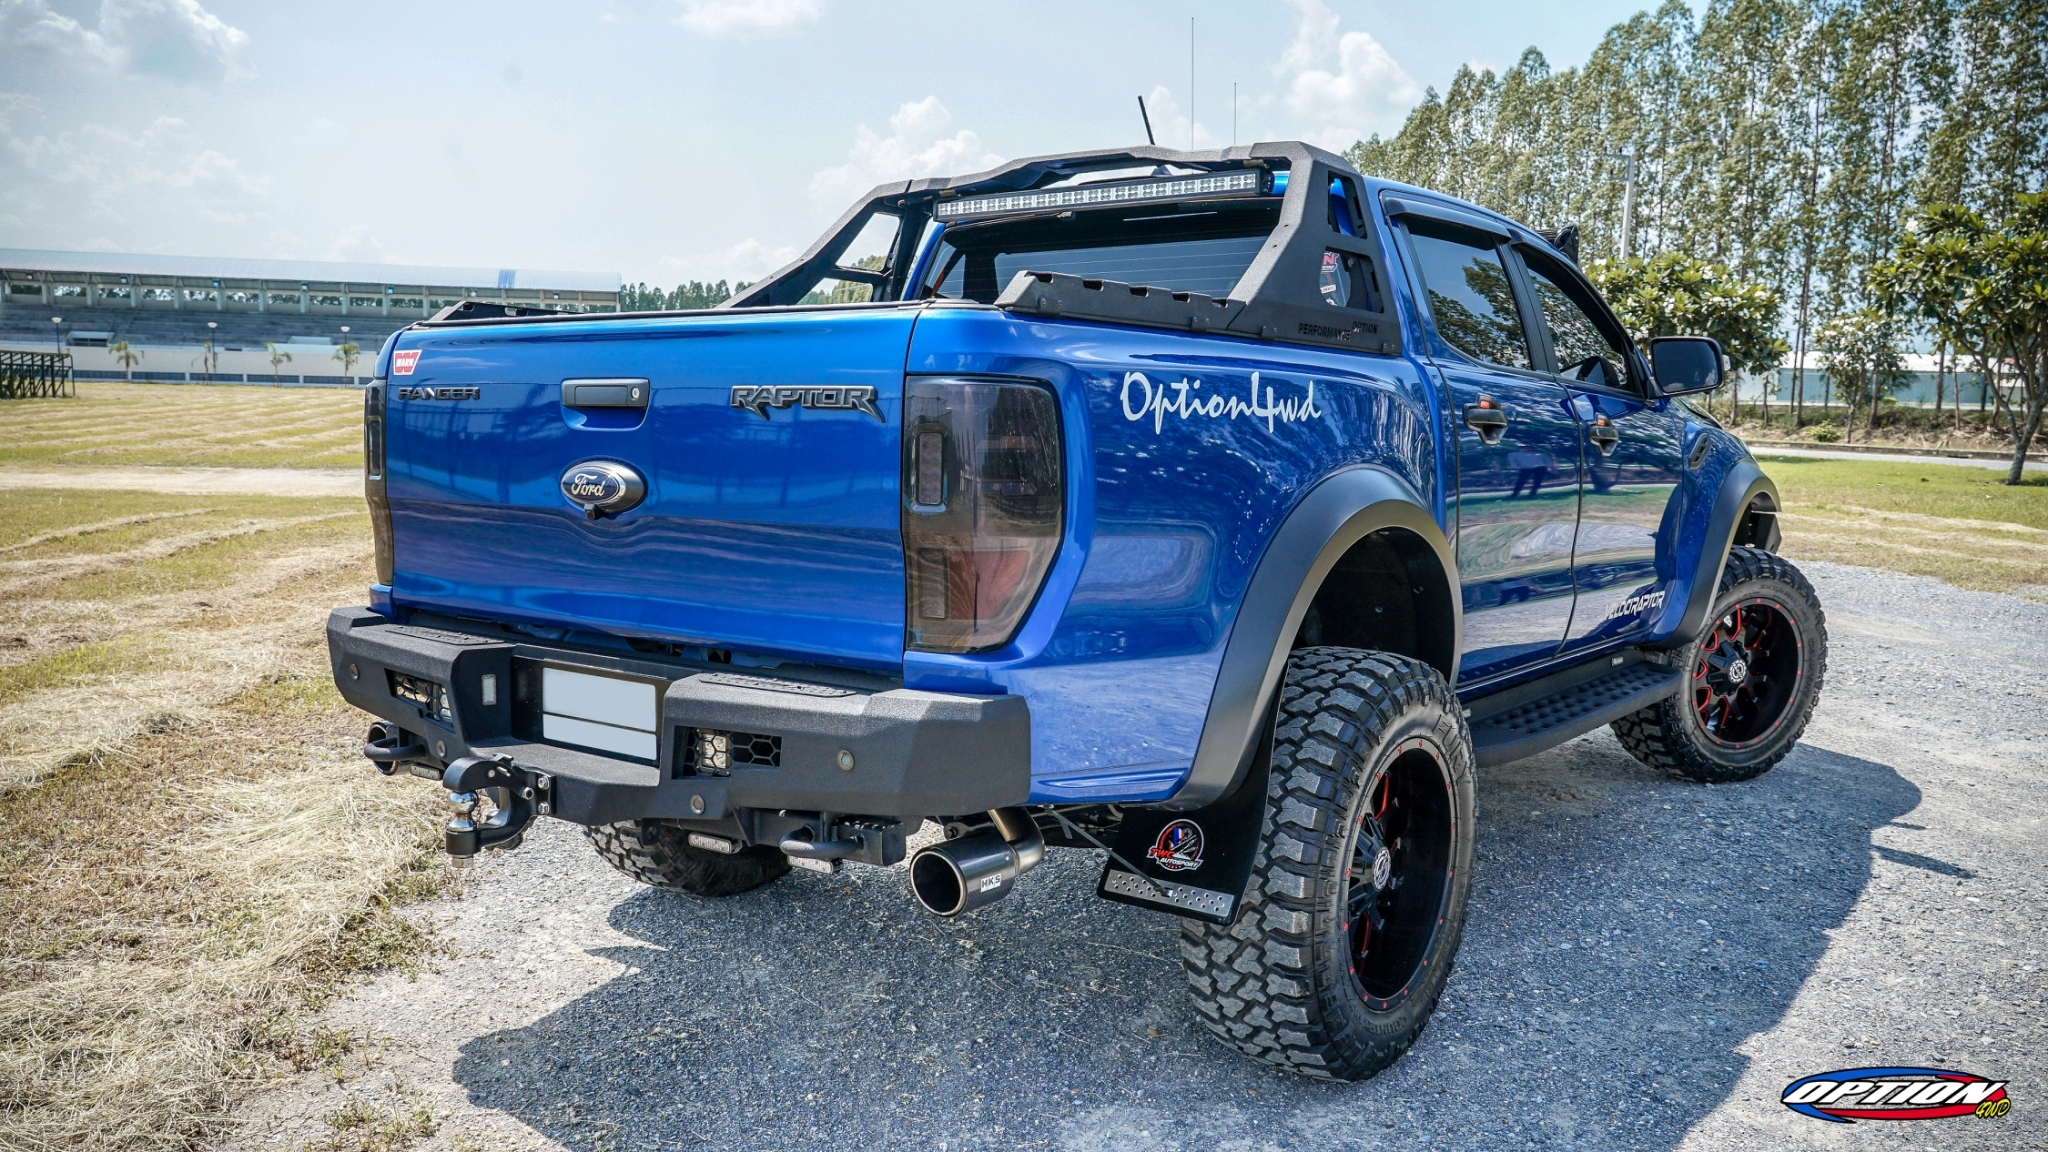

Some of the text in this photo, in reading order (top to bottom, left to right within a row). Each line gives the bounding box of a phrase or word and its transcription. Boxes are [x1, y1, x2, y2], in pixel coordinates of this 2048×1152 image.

[1298, 323, 1352, 341] PERFORMANCE
[1352, 321, 1378, 334] OPTION
[398, 386, 480, 400] RANGER
[730, 385, 885, 423] RAPTOR
[571, 473, 606, 496] Ford
[1149, 848, 1176, 859] TWC
[1160, 857, 1198, 868] AUTOSPORT
[981, 874, 1001, 888] HKS
